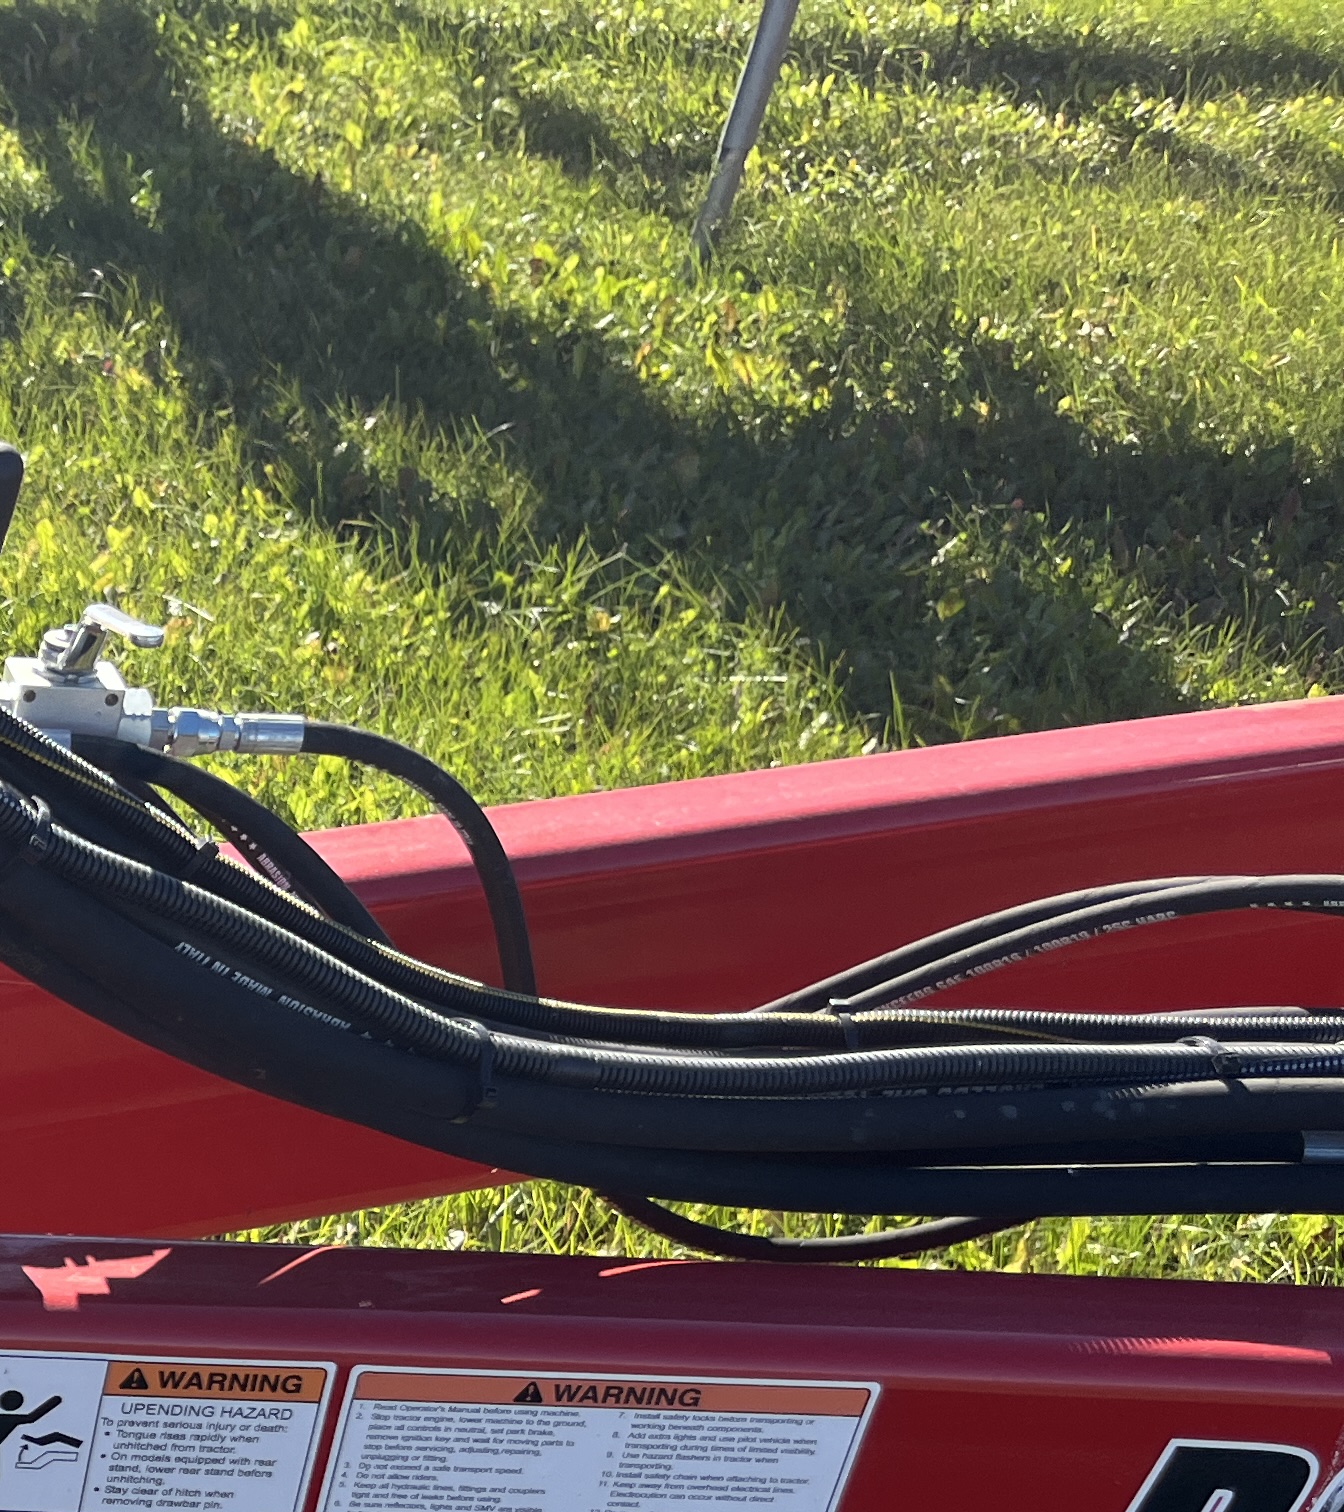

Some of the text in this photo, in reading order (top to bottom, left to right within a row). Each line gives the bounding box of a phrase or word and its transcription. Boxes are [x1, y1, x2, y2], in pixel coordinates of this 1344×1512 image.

[256, 852, 292, 891] ABRASION
[157, 1370, 303, 1394] WARNING
[552, 1384, 702, 1406] WARNING
[120, 1402, 294, 1421] UPENDING HAZARD
[116, 1418, 159, 1429] prevent
[162, 1420, 202, 1429] serious
[205, 1422, 236, 1432] injury
[114, 1429, 259, 1443] Tongue rises rapidly when
[112, 1441, 167, 1450] unhitched
[170, 1443, 195, 1451] from
[110, 1452, 127, 1460] On
[130, 1453, 171, 1461] models
[173, 1455, 225, 1466] equipped
[228, 1457, 251, 1465] with
[145, 1465, 175, 1473] lower
[203, 1467, 234, 1475] stand
[237, 1469, 272, 1477] before
[103, 1485, 128, 1495] Stay
[131, 1487, 158, 1495] clear
[175, 1488, 201, 1496] hitch
[204, 1490, 234, 1498] when
[101, 1497, 152, 1507] removing
[155, 1499, 200, 1508] drawbar
